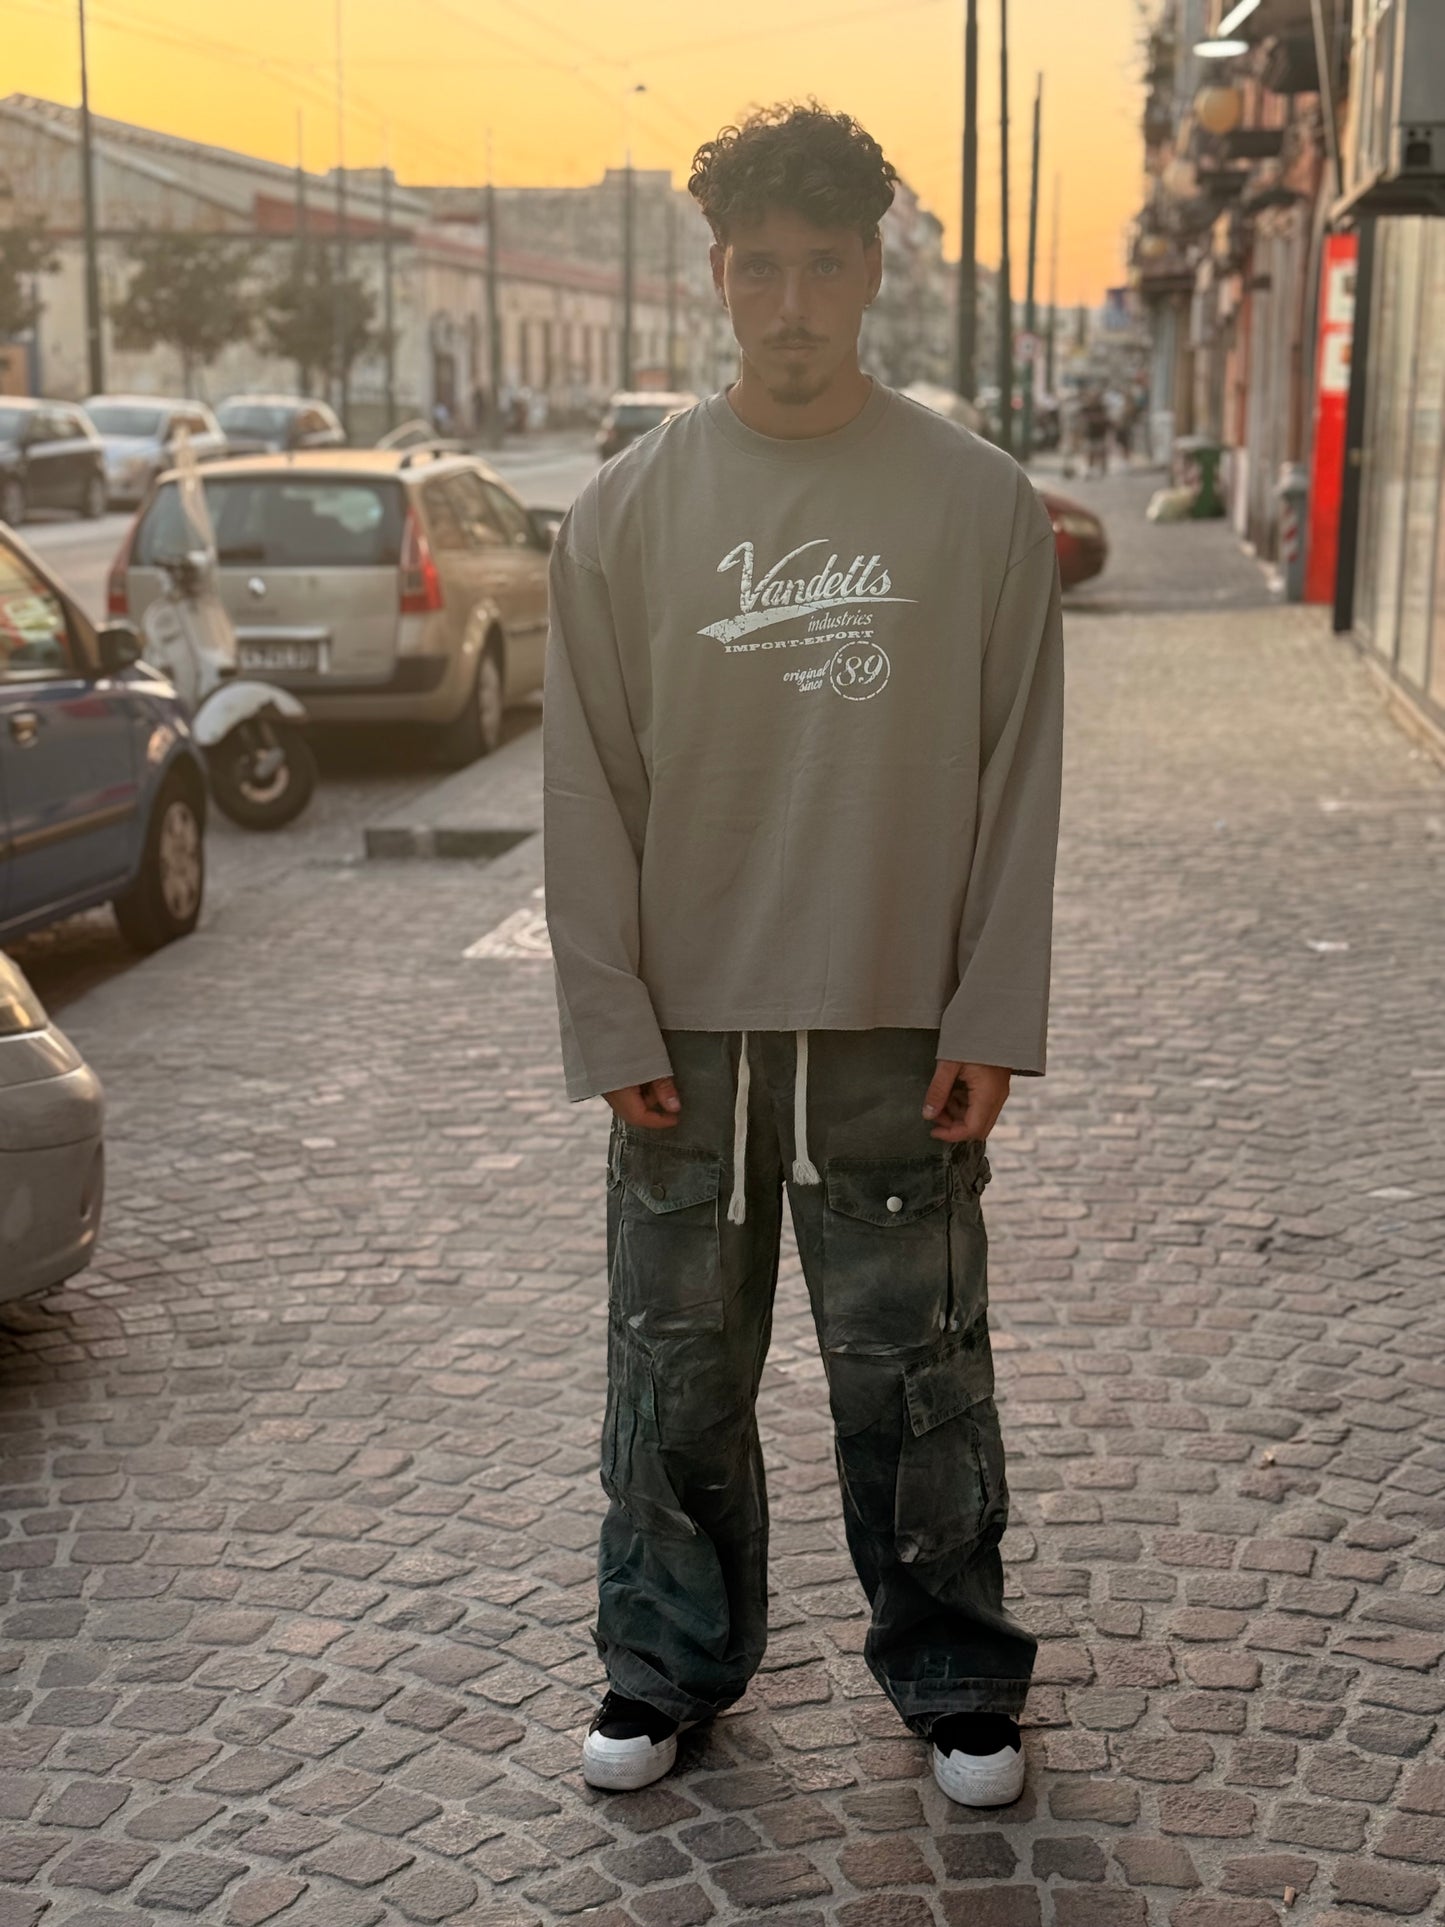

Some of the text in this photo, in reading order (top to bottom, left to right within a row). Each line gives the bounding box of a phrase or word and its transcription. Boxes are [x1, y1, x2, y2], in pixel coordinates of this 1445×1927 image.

[808, 610, 873, 632] industries
[725, 630, 874, 654] IMPORT-EXPORT
[783, 660, 831, 685] original
[799, 679, 823, 692] since
